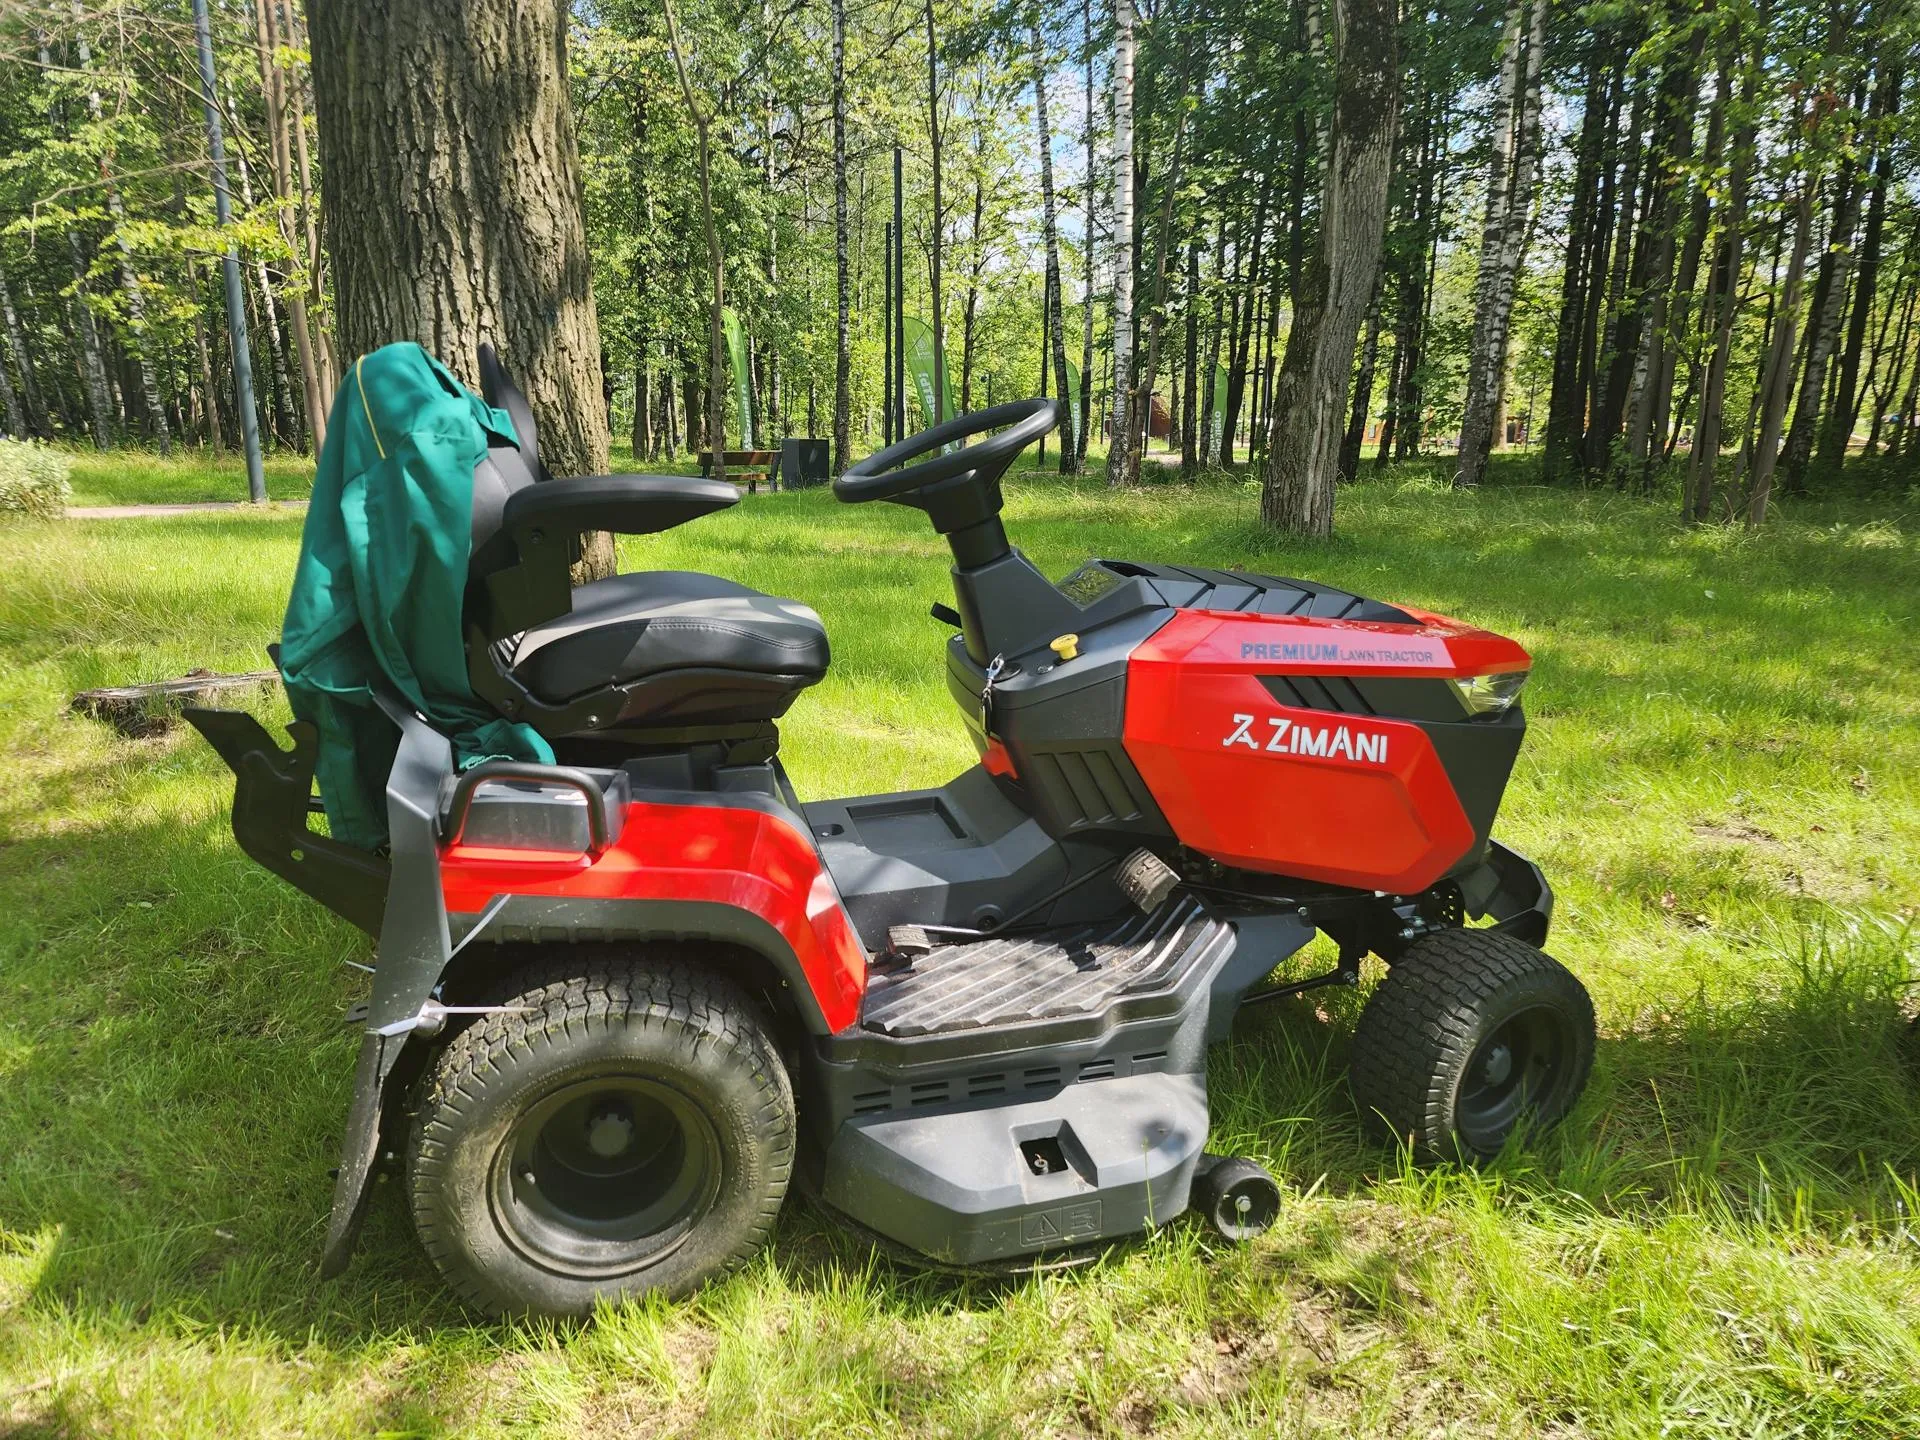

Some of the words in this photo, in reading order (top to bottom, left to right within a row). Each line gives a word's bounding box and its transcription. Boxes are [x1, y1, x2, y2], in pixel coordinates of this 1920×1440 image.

[1241, 642, 1338, 661] PREMIUM
[1340, 649, 1376, 662] LAWN
[1377, 650, 1434, 663] TRACTOR
[1265, 717, 1388, 764] ZIMANI
